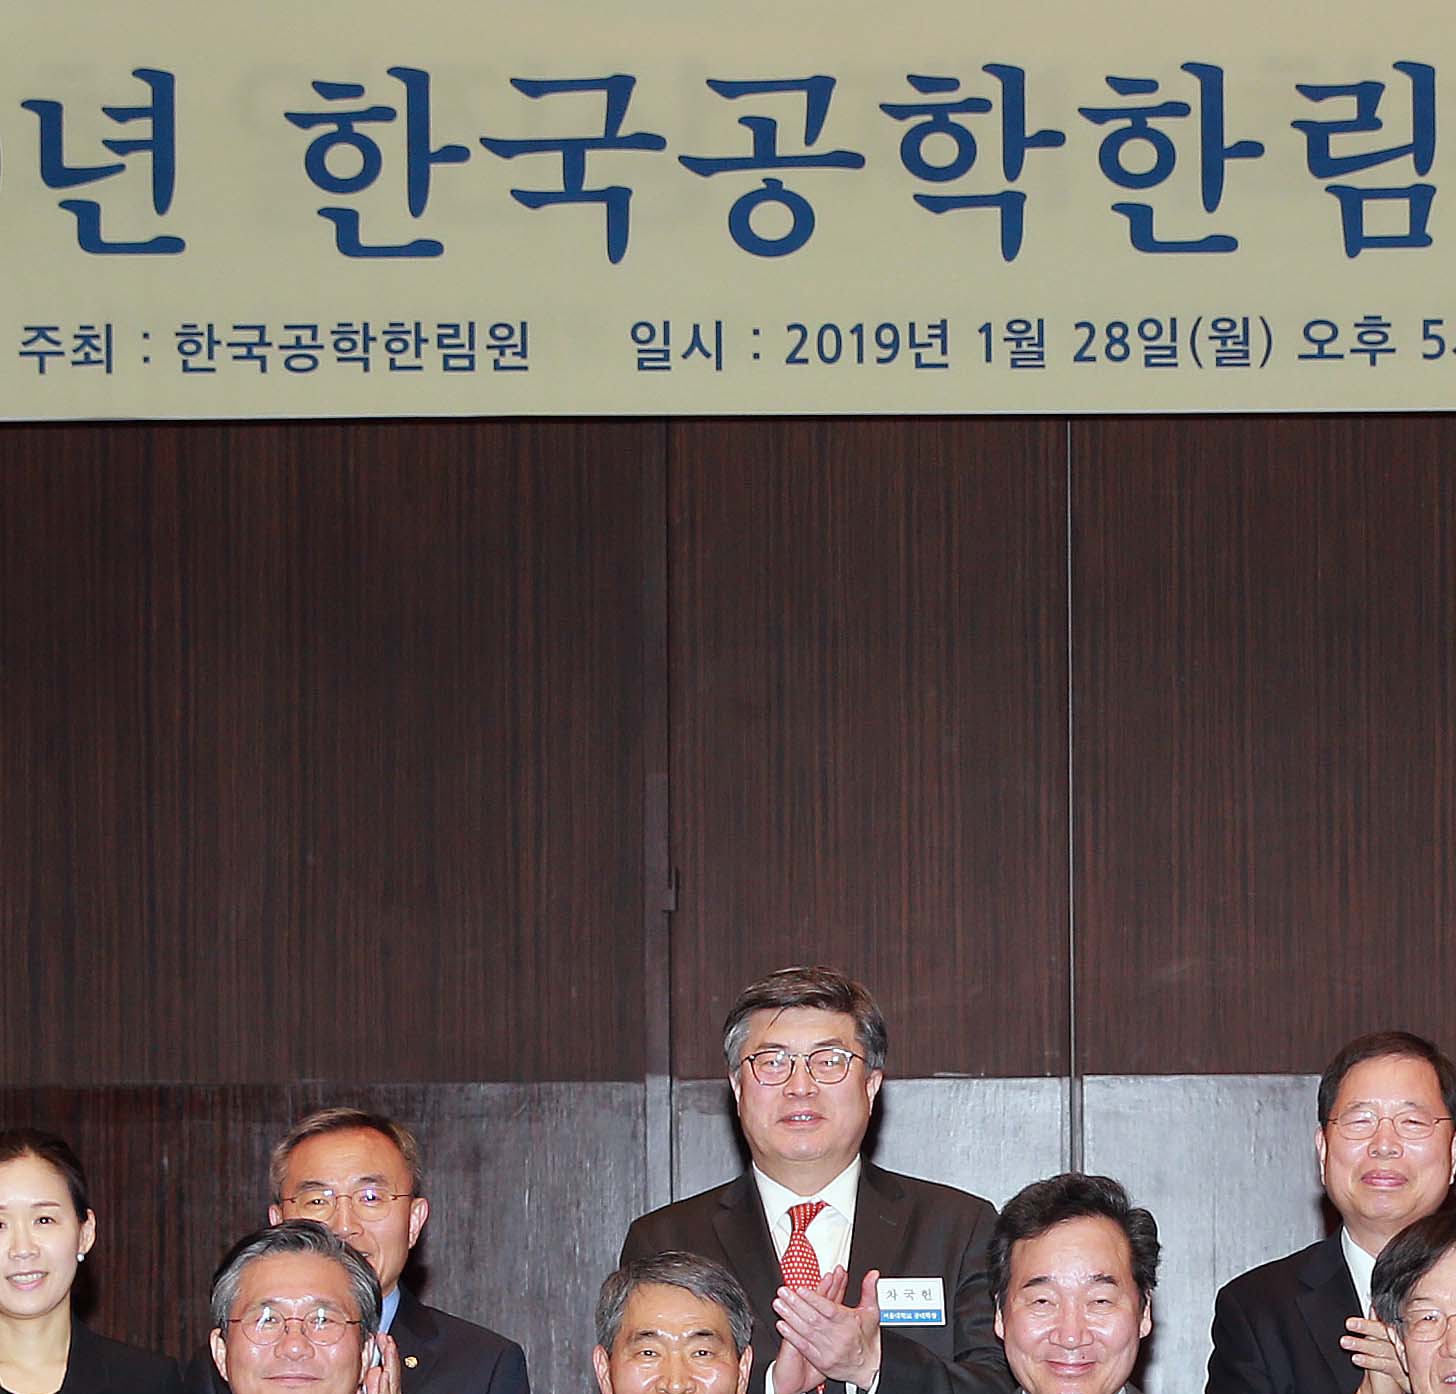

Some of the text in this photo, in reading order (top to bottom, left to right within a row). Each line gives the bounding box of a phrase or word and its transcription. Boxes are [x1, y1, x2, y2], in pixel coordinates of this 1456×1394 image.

[19, 324, 112, 374] 주최
[175, 321, 528, 373] 한국공학한림원
[631, 320, 722, 371] 일시
[786, 319, 949, 368] 2019년
[978, 318, 1045, 368] 1월
[1074, 316, 1272, 368] 28일(월)
[1298, 316, 1396, 366] 오후
